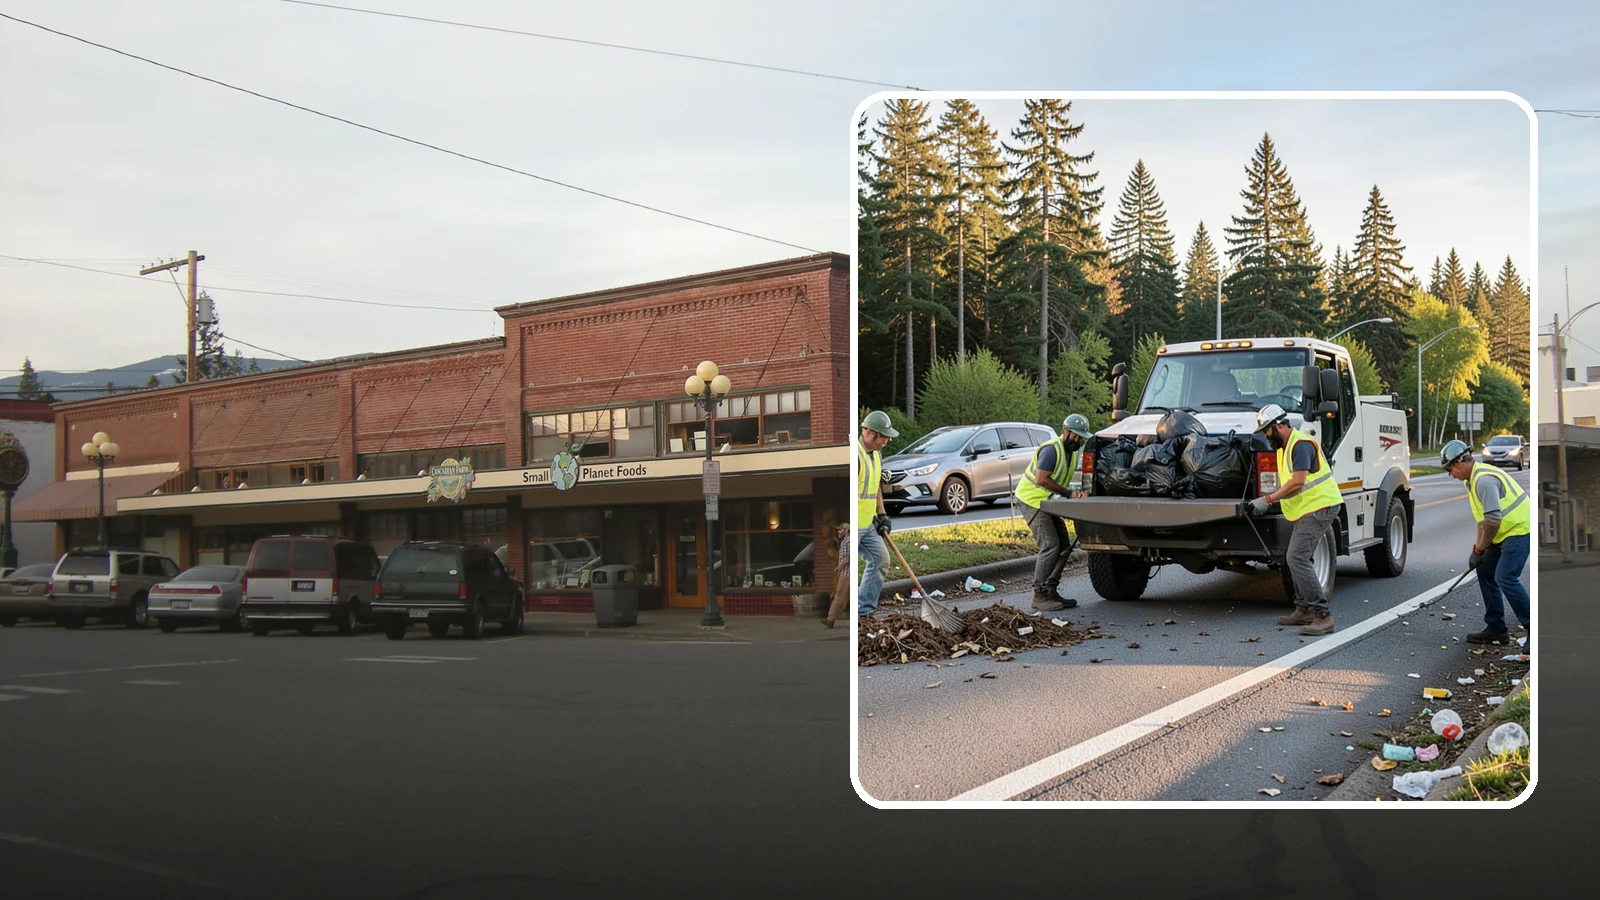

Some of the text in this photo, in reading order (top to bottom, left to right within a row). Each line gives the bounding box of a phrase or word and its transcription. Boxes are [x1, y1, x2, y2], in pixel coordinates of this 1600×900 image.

[523, 464, 647, 483] Small Planet Foods
